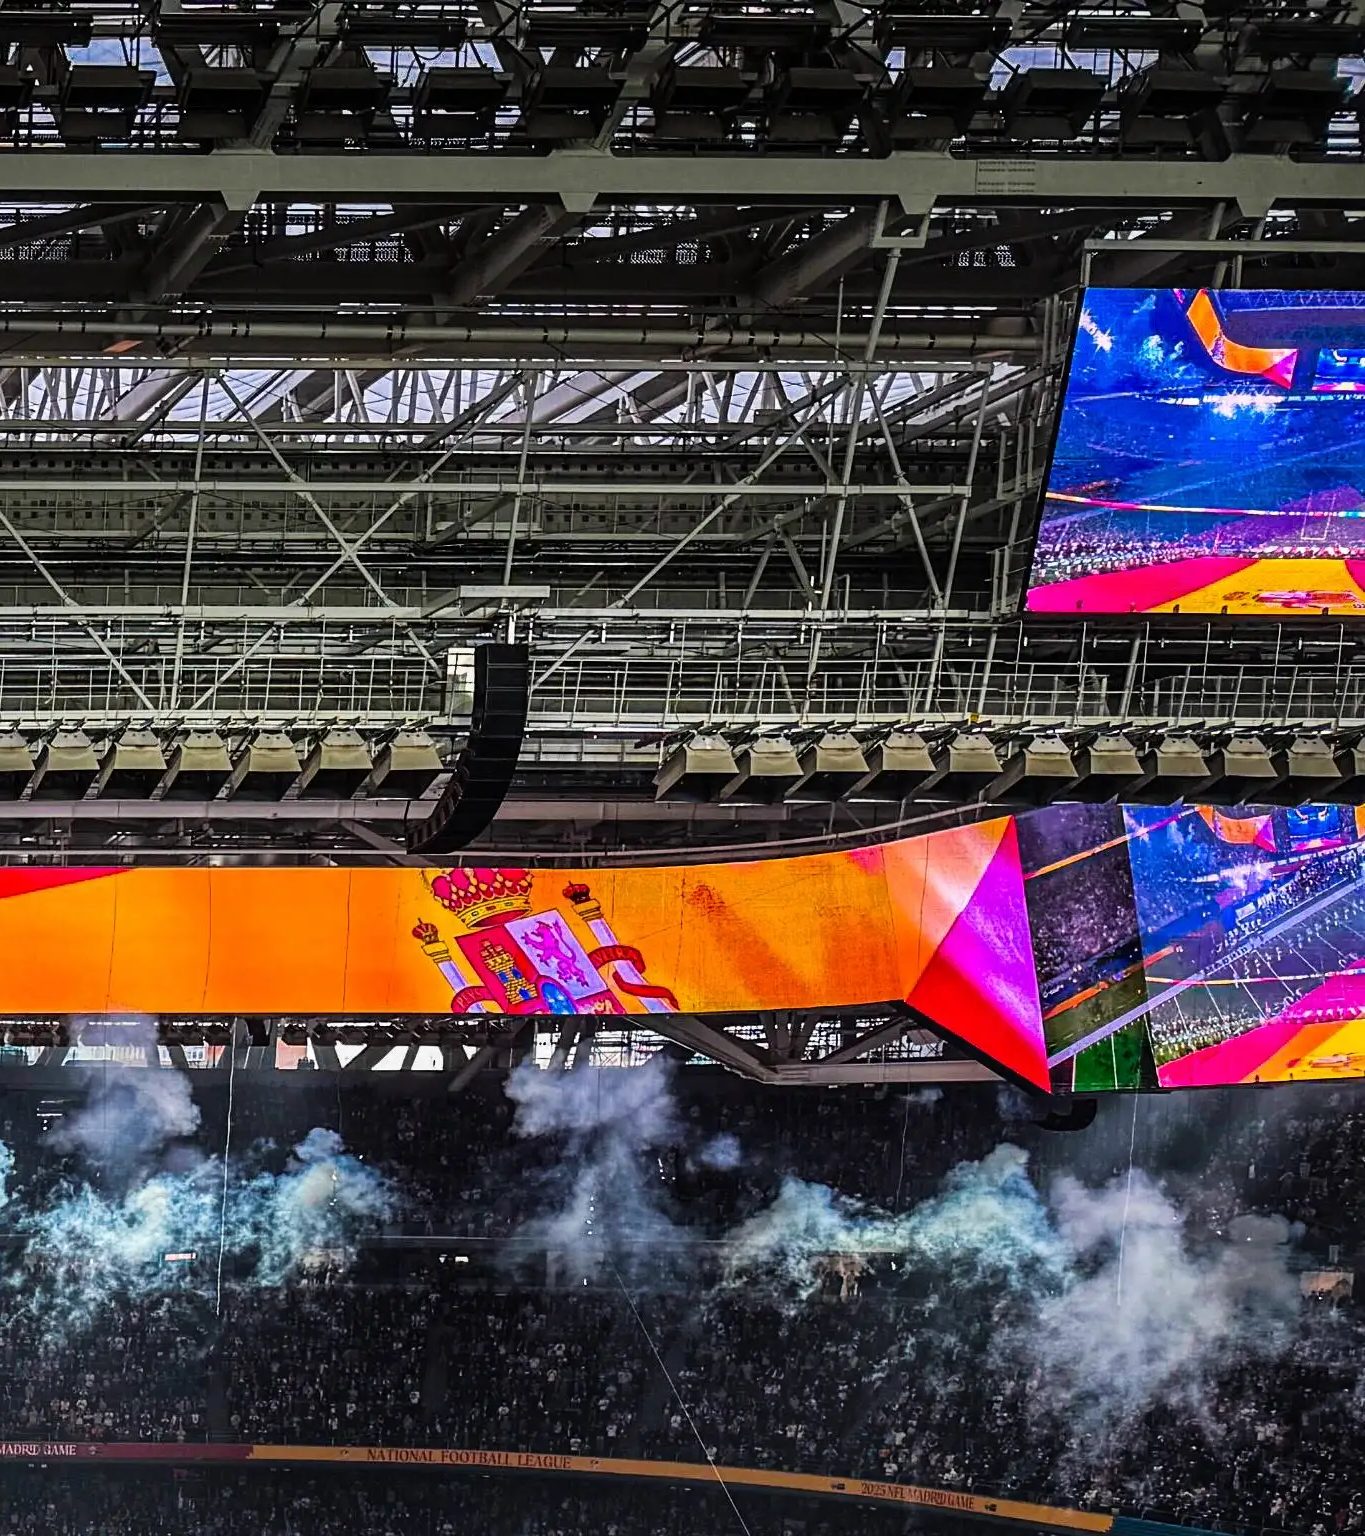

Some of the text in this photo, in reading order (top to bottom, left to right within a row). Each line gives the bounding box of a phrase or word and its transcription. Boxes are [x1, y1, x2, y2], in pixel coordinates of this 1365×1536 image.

[43, 1444, 77, 1456] GAME
[367, 1449, 572, 1469] NATIONAL FOOTBALL LEAGUE
[860, 1482, 886, 1496] 2025
[886, 1485, 906, 1499] NFL
